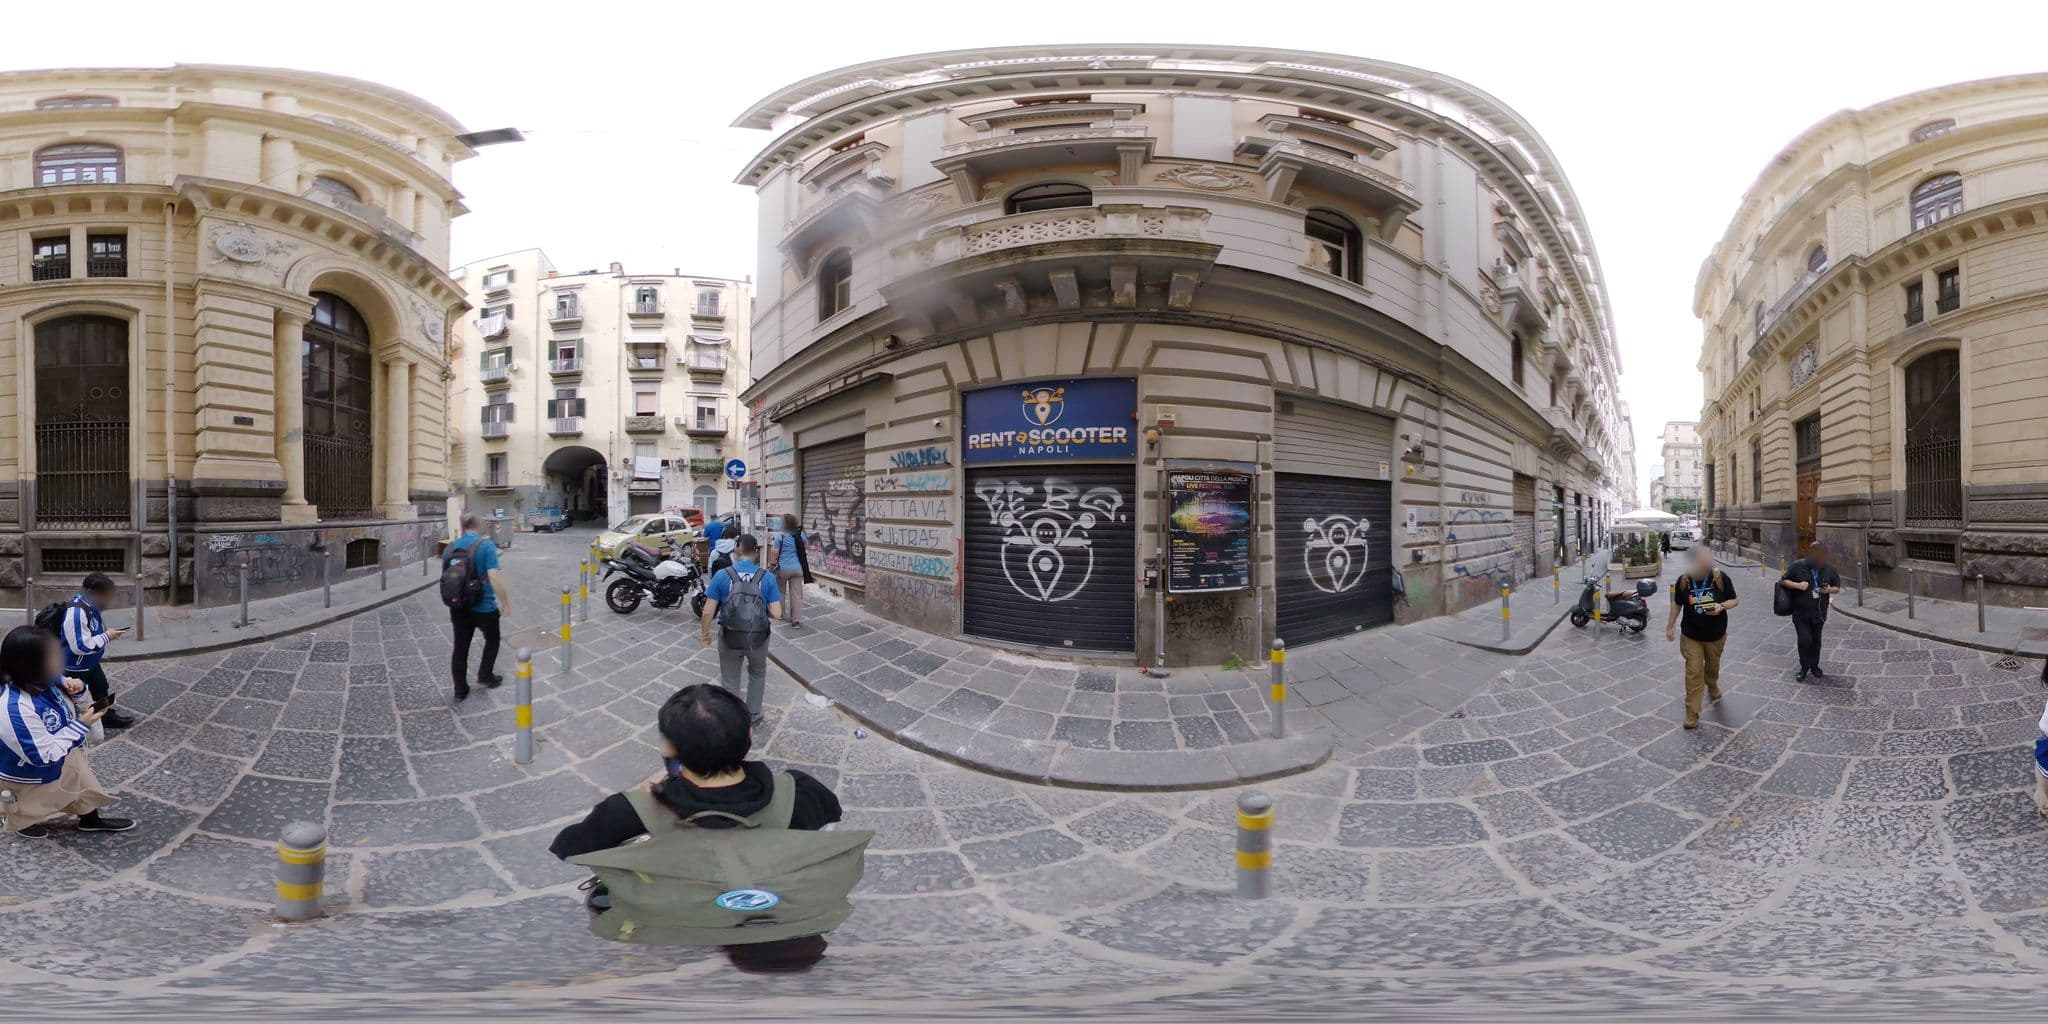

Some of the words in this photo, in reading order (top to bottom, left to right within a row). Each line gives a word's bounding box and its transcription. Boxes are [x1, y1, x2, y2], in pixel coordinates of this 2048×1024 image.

[968, 431, 1016, 449] RENT
[1016, 431, 1028, 444] a
[1029, 427, 1127, 445] SCOOTER
[1018, 445, 1069, 455] NAPOLI
[1171, 474, 1194, 482] NAPOLI
[1198, 482, 1222, 490] FESTIVAL
[921, 499, 947, 520] VIA
[881, 526, 939, 550] ULTRAS
